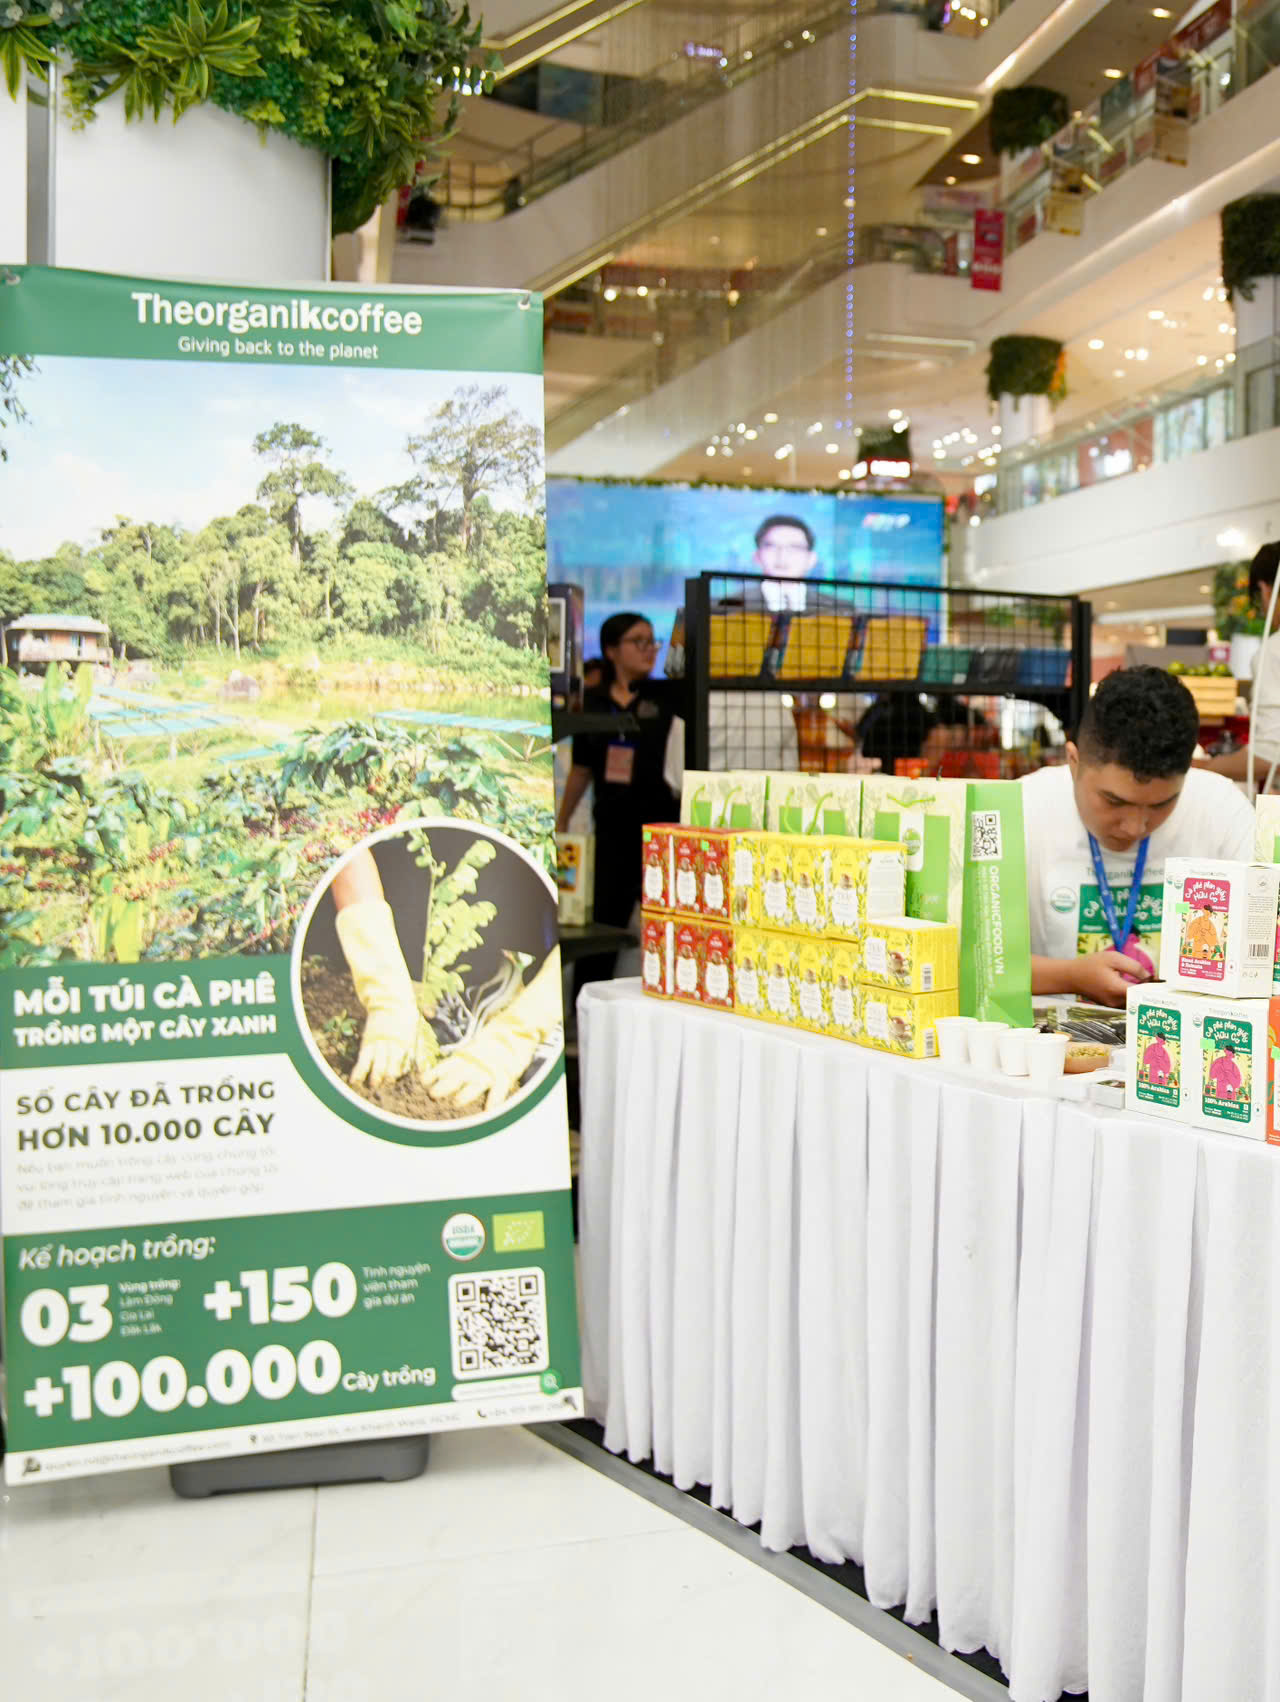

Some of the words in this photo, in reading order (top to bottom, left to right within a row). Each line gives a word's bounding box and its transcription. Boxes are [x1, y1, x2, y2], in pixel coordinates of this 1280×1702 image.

[131, 292, 422, 335] Theorganikcoffee
[177, 336, 230, 357] Giving
[234, 338, 272, 356] back
[277, 340, 294, 356] to
[297, 340, 325, 357] the
[329, 341, 379, 361] planet
[990, 865, 1004, 975] ORGANICFOOD.VN
[14, 976, 81, 1017] MỖI
[89, 978, 146, 1013] TÚI
[153, 975, 203, 1009] CÀ
[209, 970, 277, 1006] PHÊ
[102, 1017, 155, 1046] MỘT
[159, 1014, 207, 1040] CÂY
[211, 1015, 277, 1036] XANH
[16, 1086, 55, 1115] SỐ
[64, 1085, 120, 1111] CÂY
[129, 1081, 171, 1107] ĐÃ
[18, 1122, 90, 1152] HƠN
[100, 1118, 202, 1146] 10.000
[213, 1108, 276, 1137] CÂY
[19, 1244, 54, 1271] Kế
[57, 1239, 137, 1268] hoạch
[142, 1233, 216, 1260] trồng:
[203, 1261, 357, 1325] +150
[363, 1296, 382, 1309] gia
[387, 1278, 418, 1290] tham
[20, 1284, 113, 1347] 03
[24, 1340, 342, 1421] +100.000
[342, 1371, 379, 1393] Cây
[382, 1364, 436, 1388] trồng
